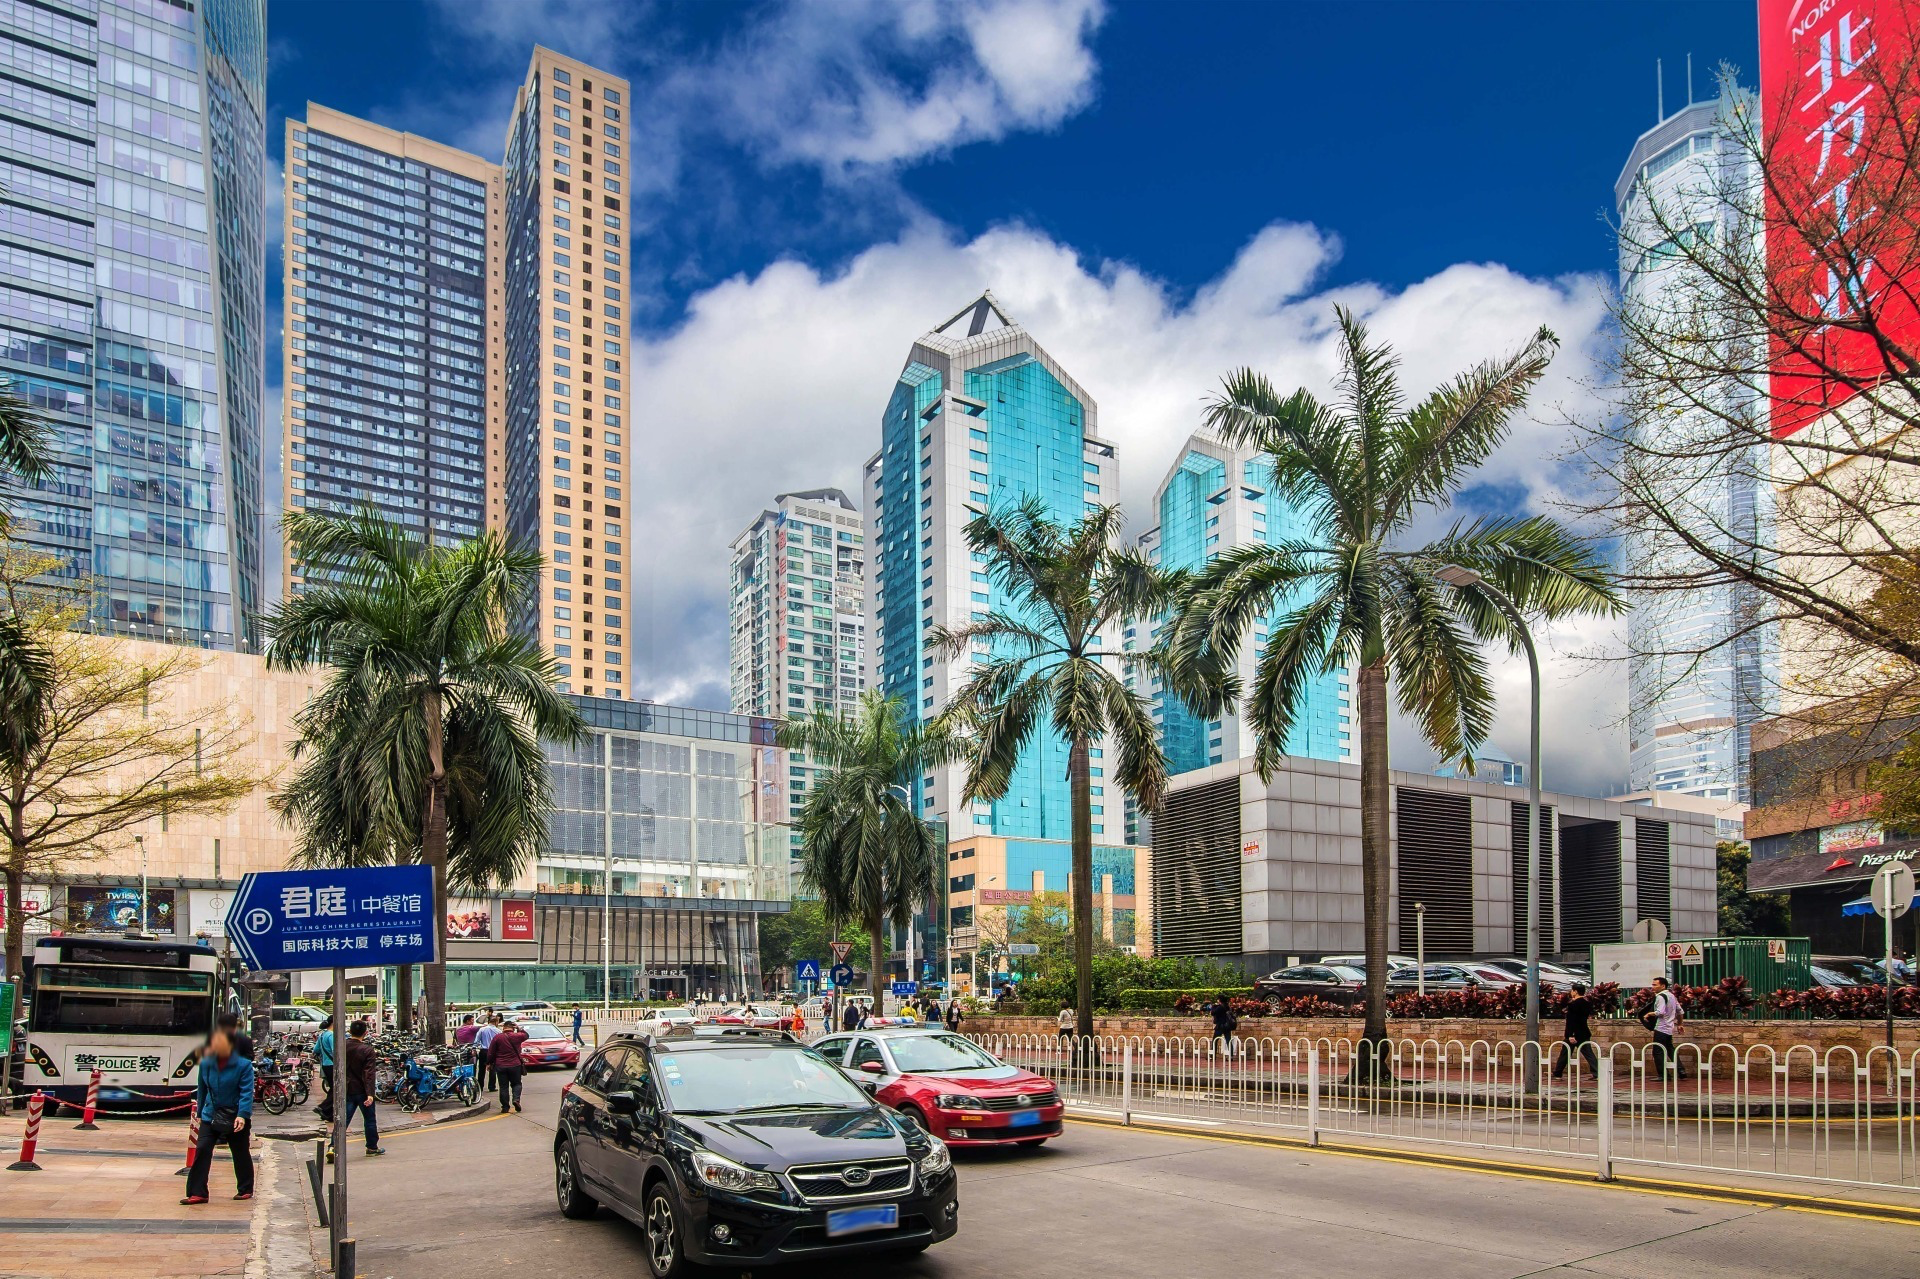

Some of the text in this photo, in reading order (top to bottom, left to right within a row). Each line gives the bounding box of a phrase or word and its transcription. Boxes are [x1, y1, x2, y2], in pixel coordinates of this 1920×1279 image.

[1859, 849, 1919, 867] Pizza Hut
[280, 885, 421, 918] 君庭 中餐馆
[282, 933, 422, 953] 国际科技大厦 停车场
[837, 945, 847, 953] 让
[74, 1053, 161, 1072] 警 POLICE 察
